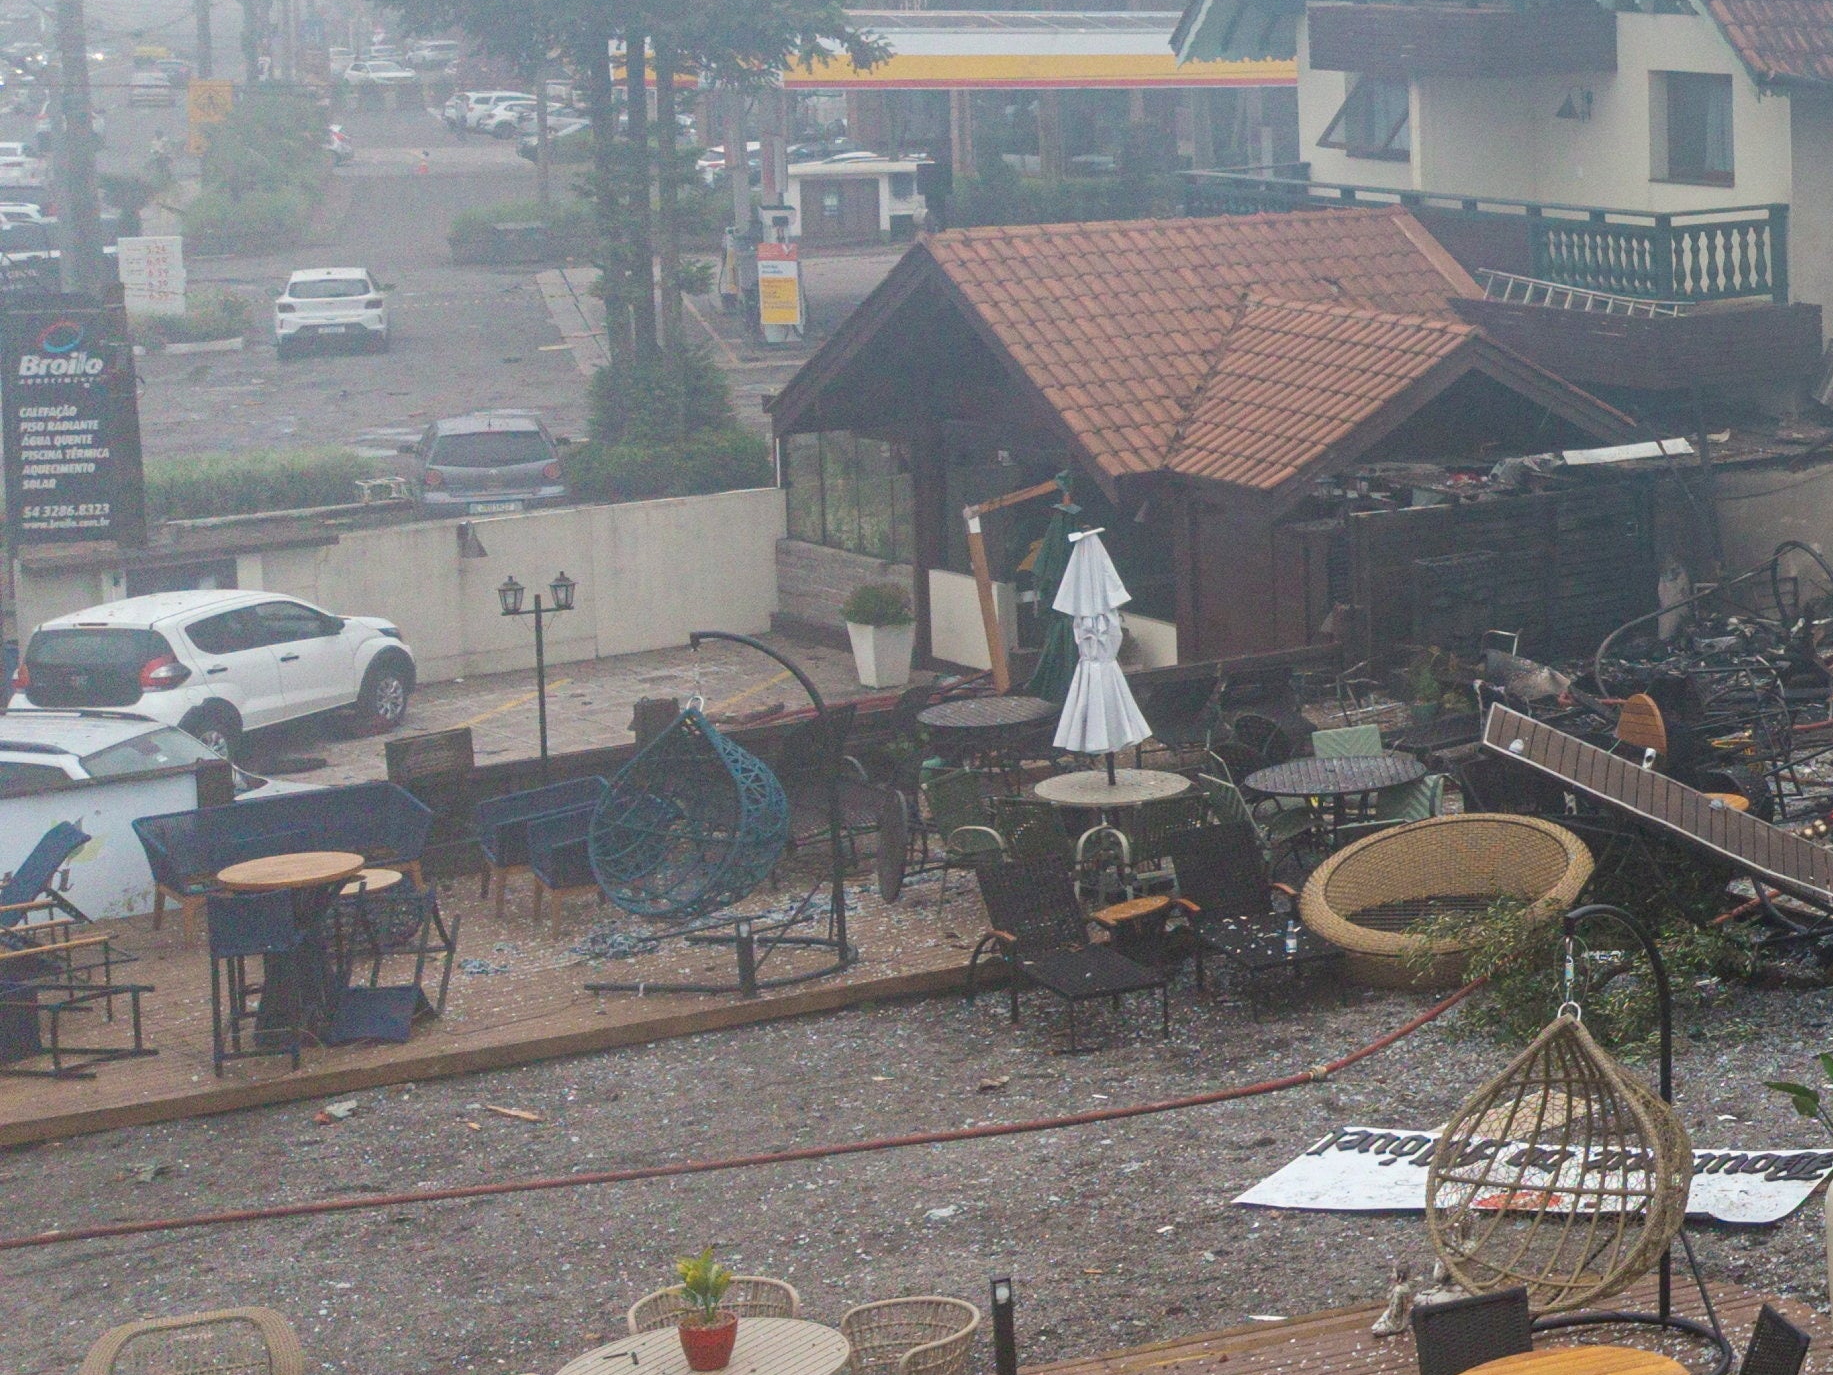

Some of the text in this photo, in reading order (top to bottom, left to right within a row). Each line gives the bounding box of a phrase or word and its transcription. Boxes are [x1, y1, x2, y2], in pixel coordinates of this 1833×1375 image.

[18, 352, 104, 376] Broilo
[20, 405, 78, 419] CALEFAÇÃO
[20, 420, 100, 433] PISO RADIANTE
[21, 434, 94, 447] ÁGUA QUENTE
[21, 447, 110, 461] PISCINA TÉRMICA
[22, 463, 96, 476] AQUECIMENTO
[22, 478, 57, 489] SOLAR
[23, 503, 110, 518] 54 3286.8323
